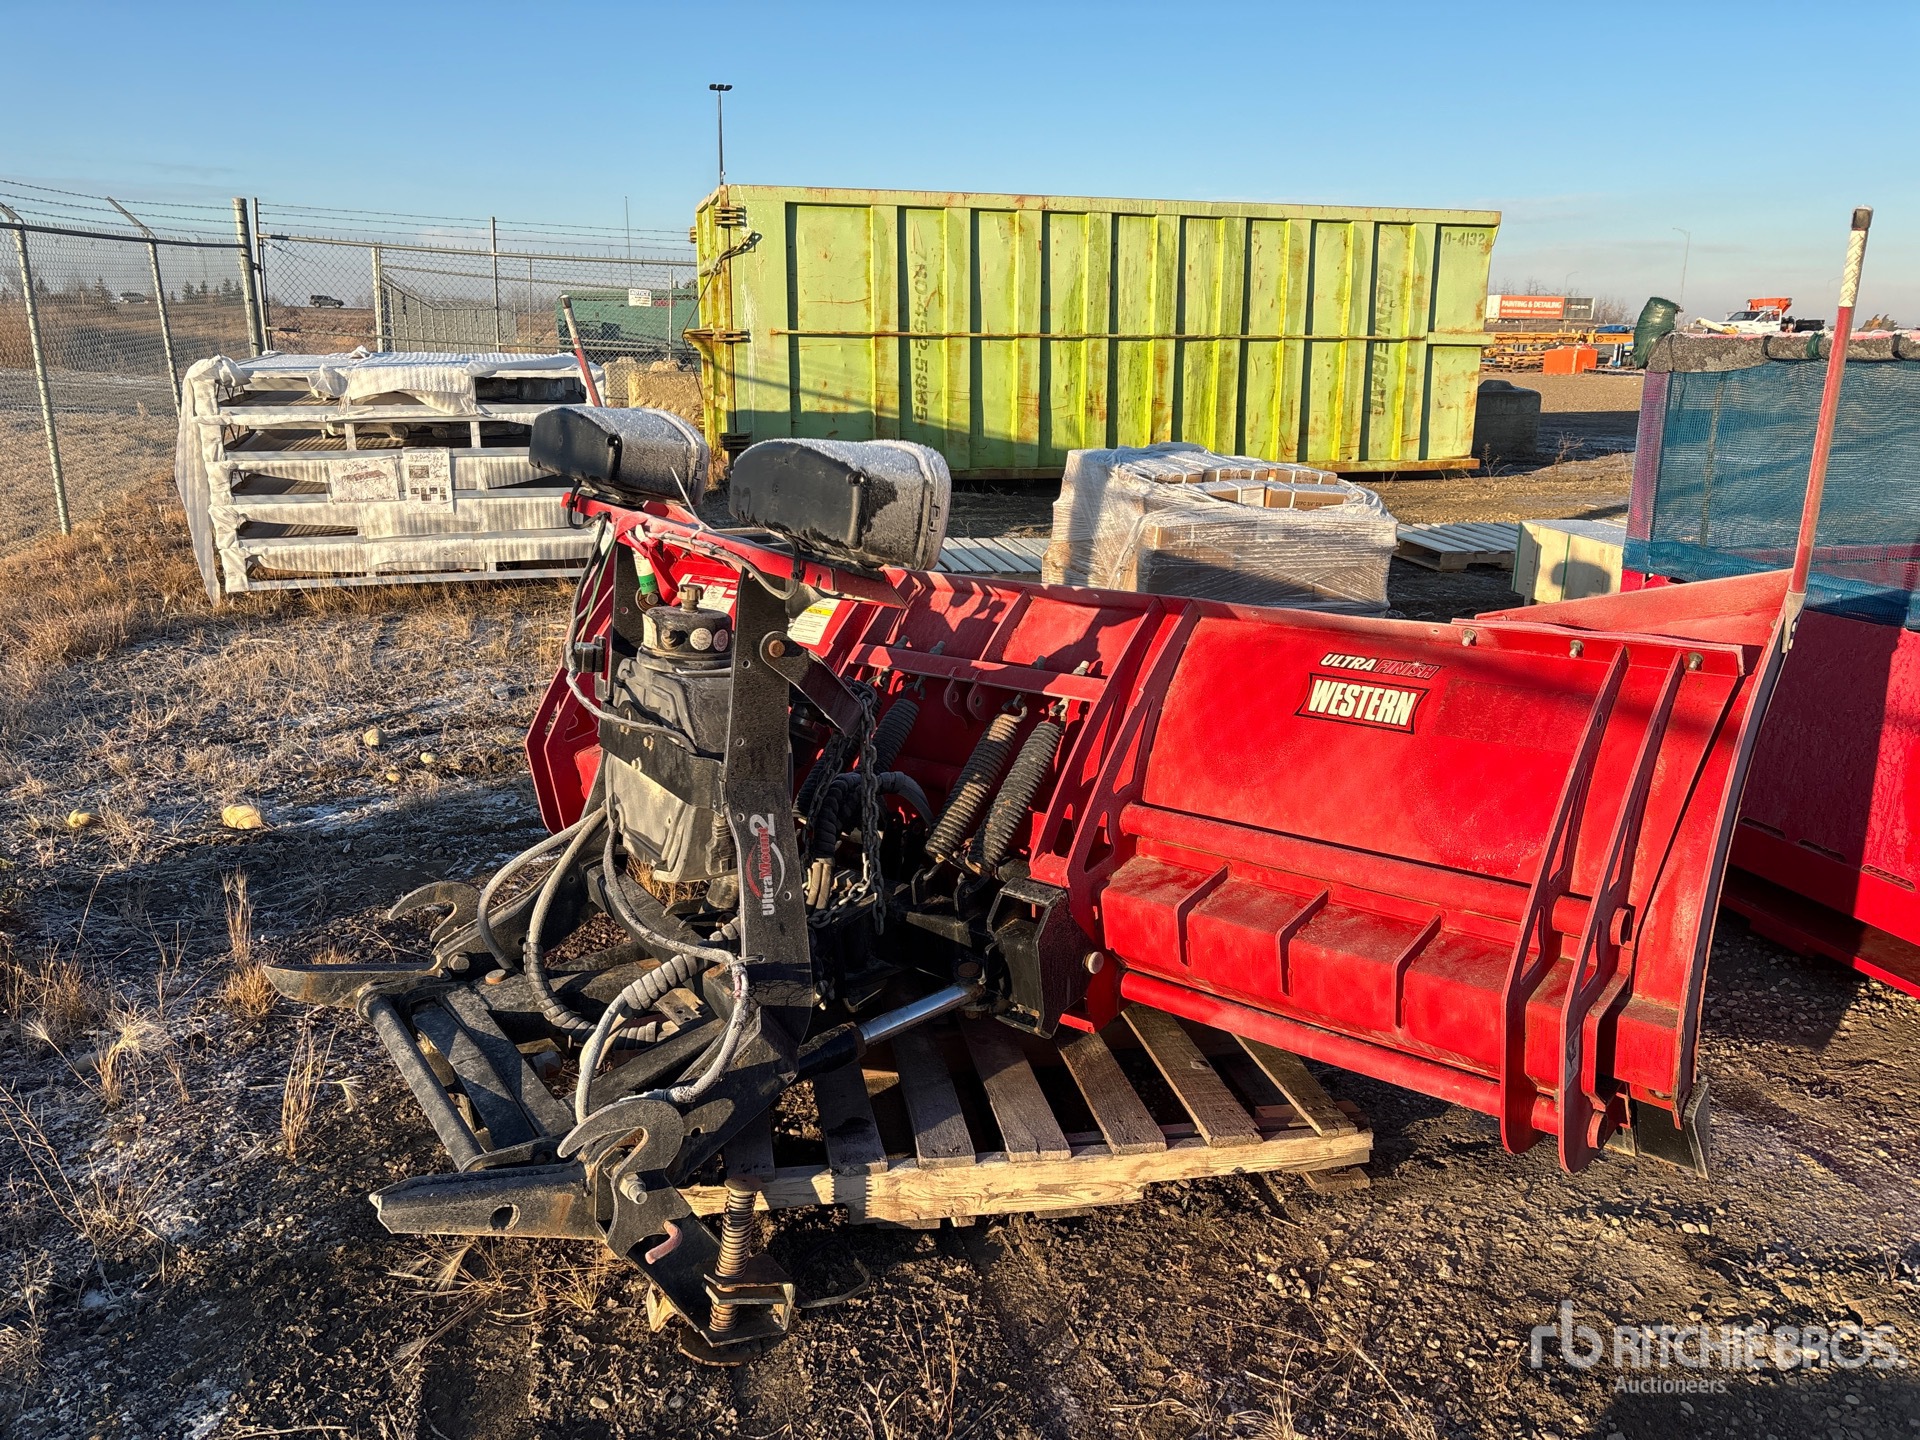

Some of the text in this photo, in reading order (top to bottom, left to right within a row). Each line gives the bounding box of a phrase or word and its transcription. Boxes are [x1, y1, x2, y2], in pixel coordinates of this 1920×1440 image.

[1501, 300, 1528, 308] PAINTING
[1534, 301, 1562, 309] DETAILING
[1320, 653, 1440, 679] ULTRA FINISH
[1308, 679, 1417, 726] WESTERN
